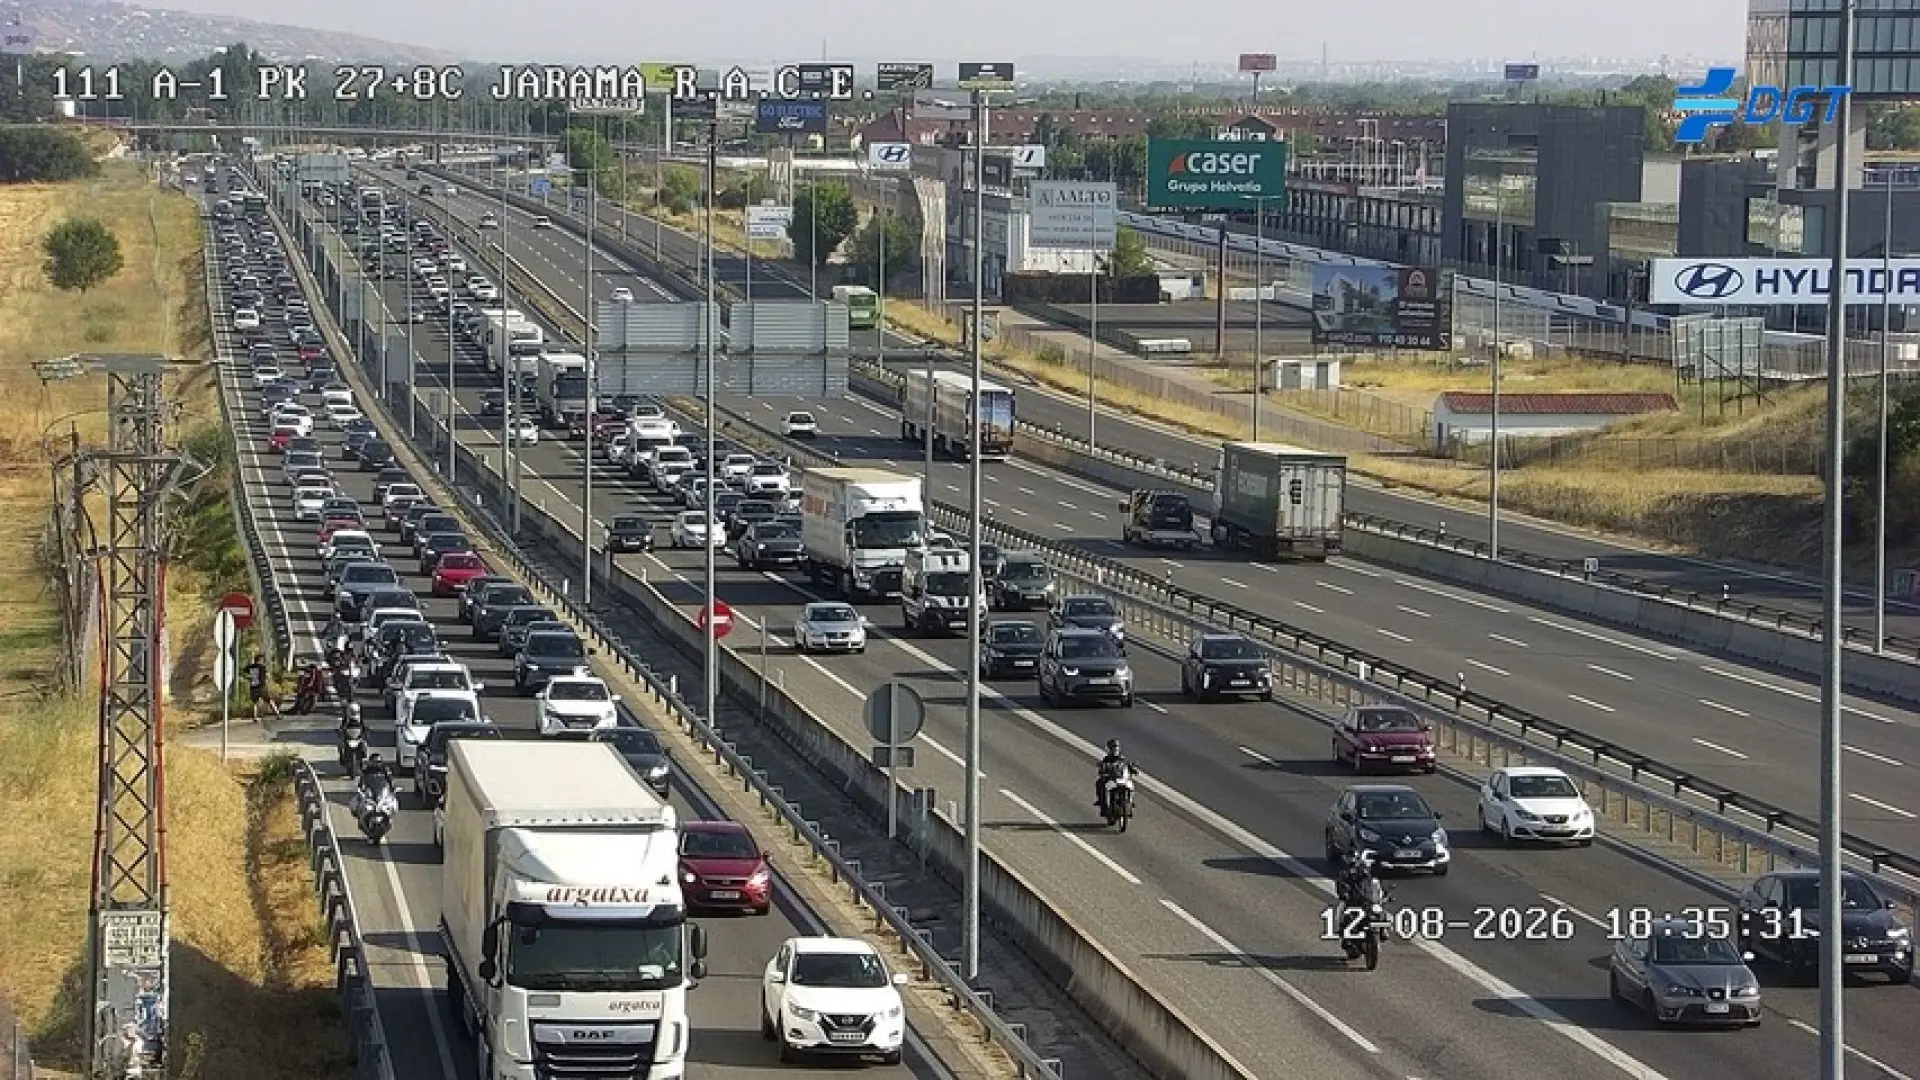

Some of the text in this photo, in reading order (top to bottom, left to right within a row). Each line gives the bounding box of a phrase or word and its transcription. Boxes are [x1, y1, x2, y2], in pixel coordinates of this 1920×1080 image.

[1187, 152, 1261, 174] caser
[1167, 179, 1262, 194] Grupo Helvetia
[1056, 188, 1111, 204] AALTO
[546, 887, 649, 907] argatxa
[608, 1000, 660, 1013] argatxa
[573, 1030, 615, 1039] DAF
